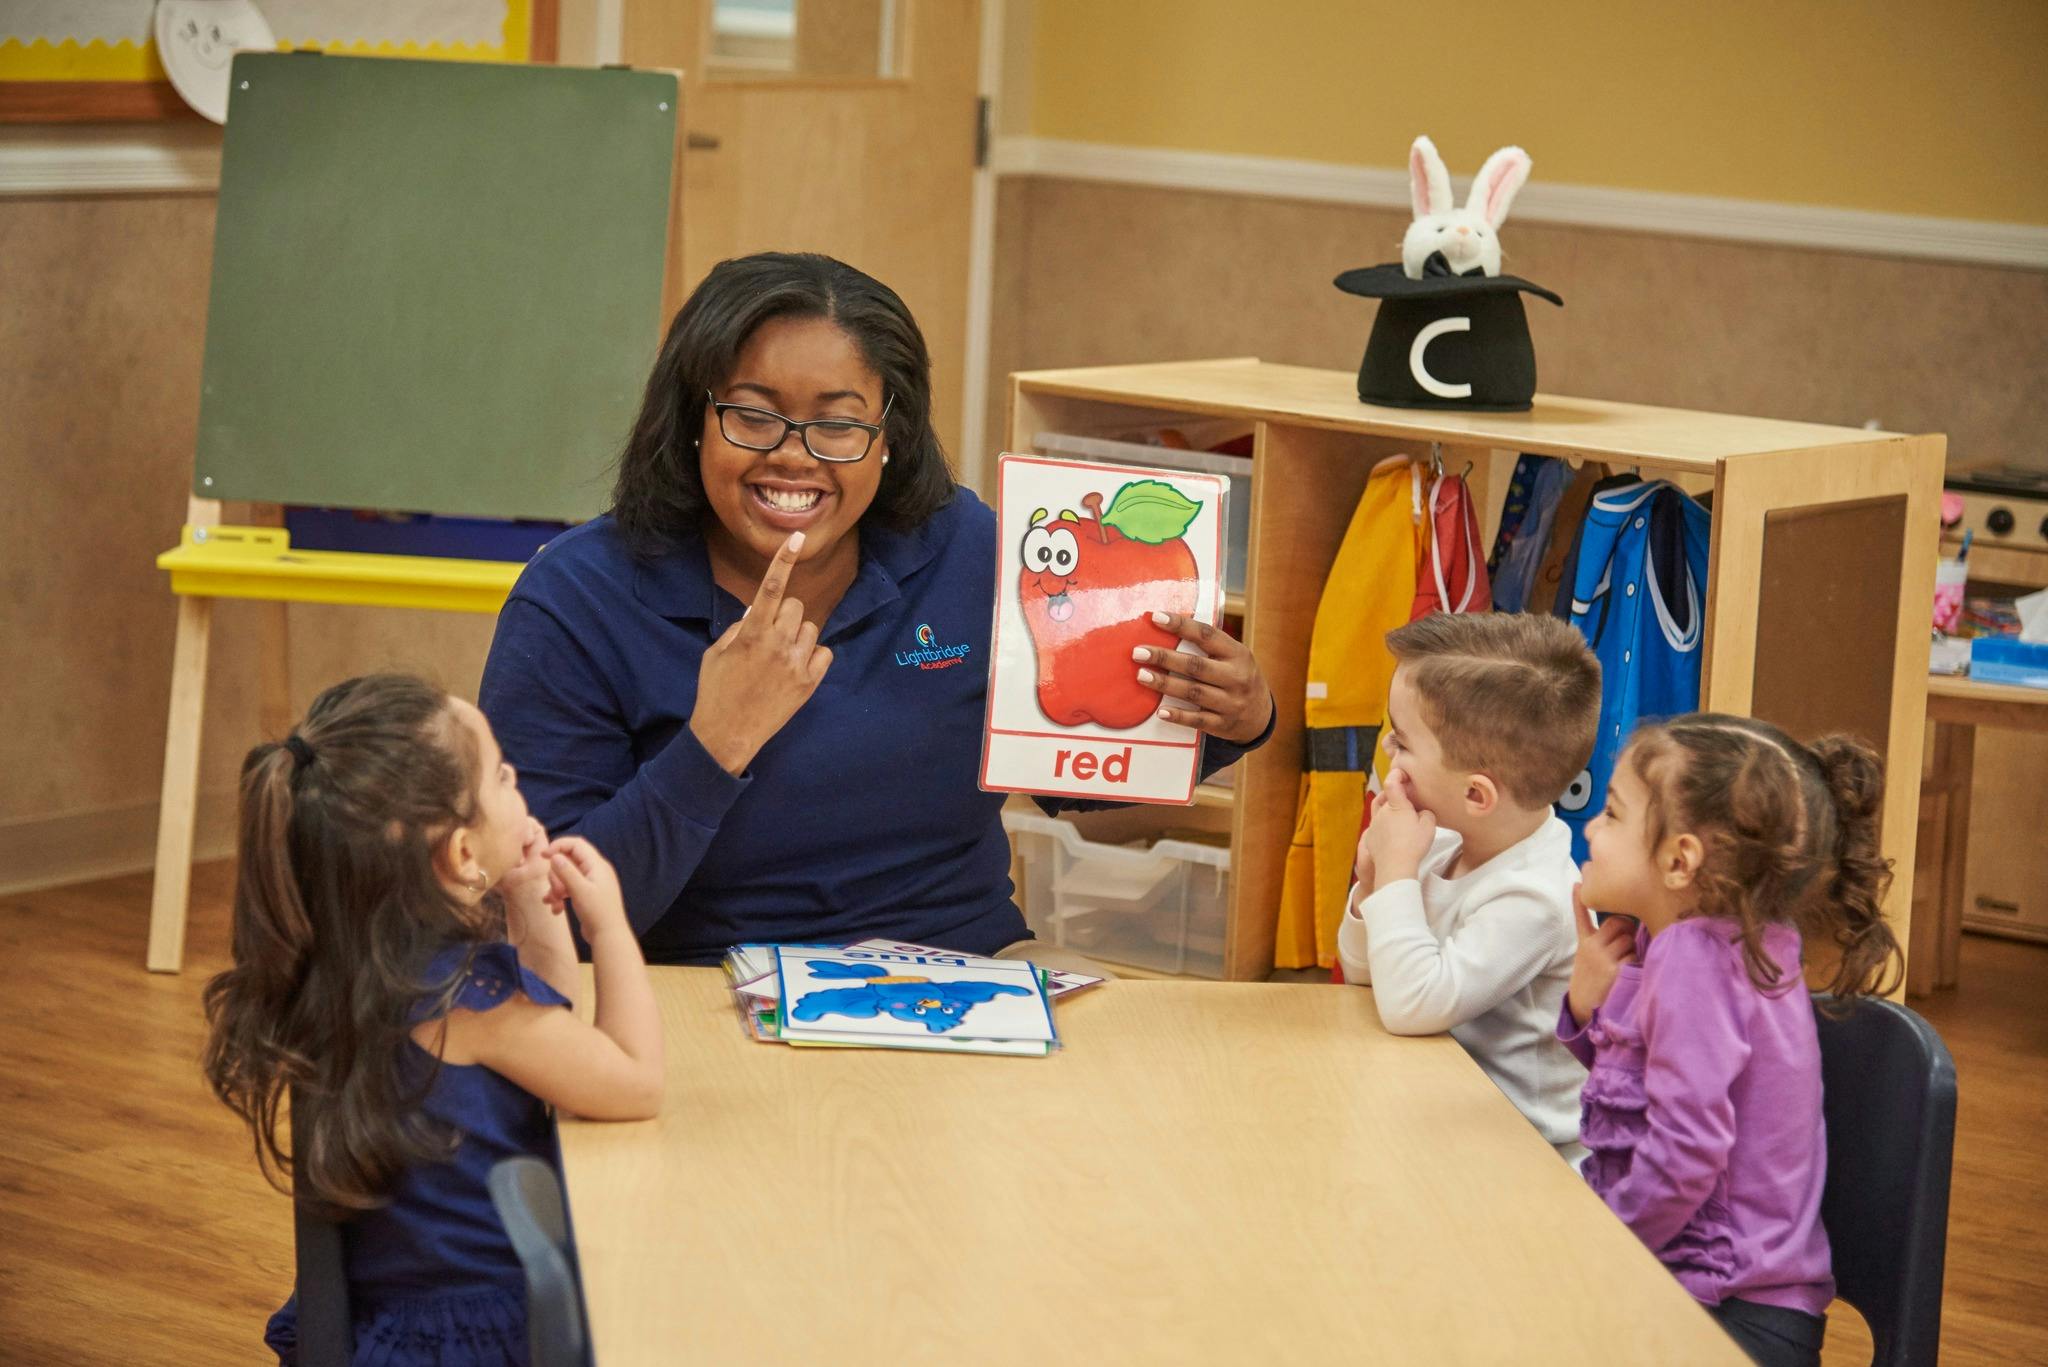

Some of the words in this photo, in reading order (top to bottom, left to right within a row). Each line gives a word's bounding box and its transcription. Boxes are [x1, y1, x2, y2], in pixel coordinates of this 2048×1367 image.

[1409, 316, 1472, 398] C
[895, 644, 971, 667] Lightbridge
[1053, 747, 1133, 783] red
[843, 952, 967, 966] blue
